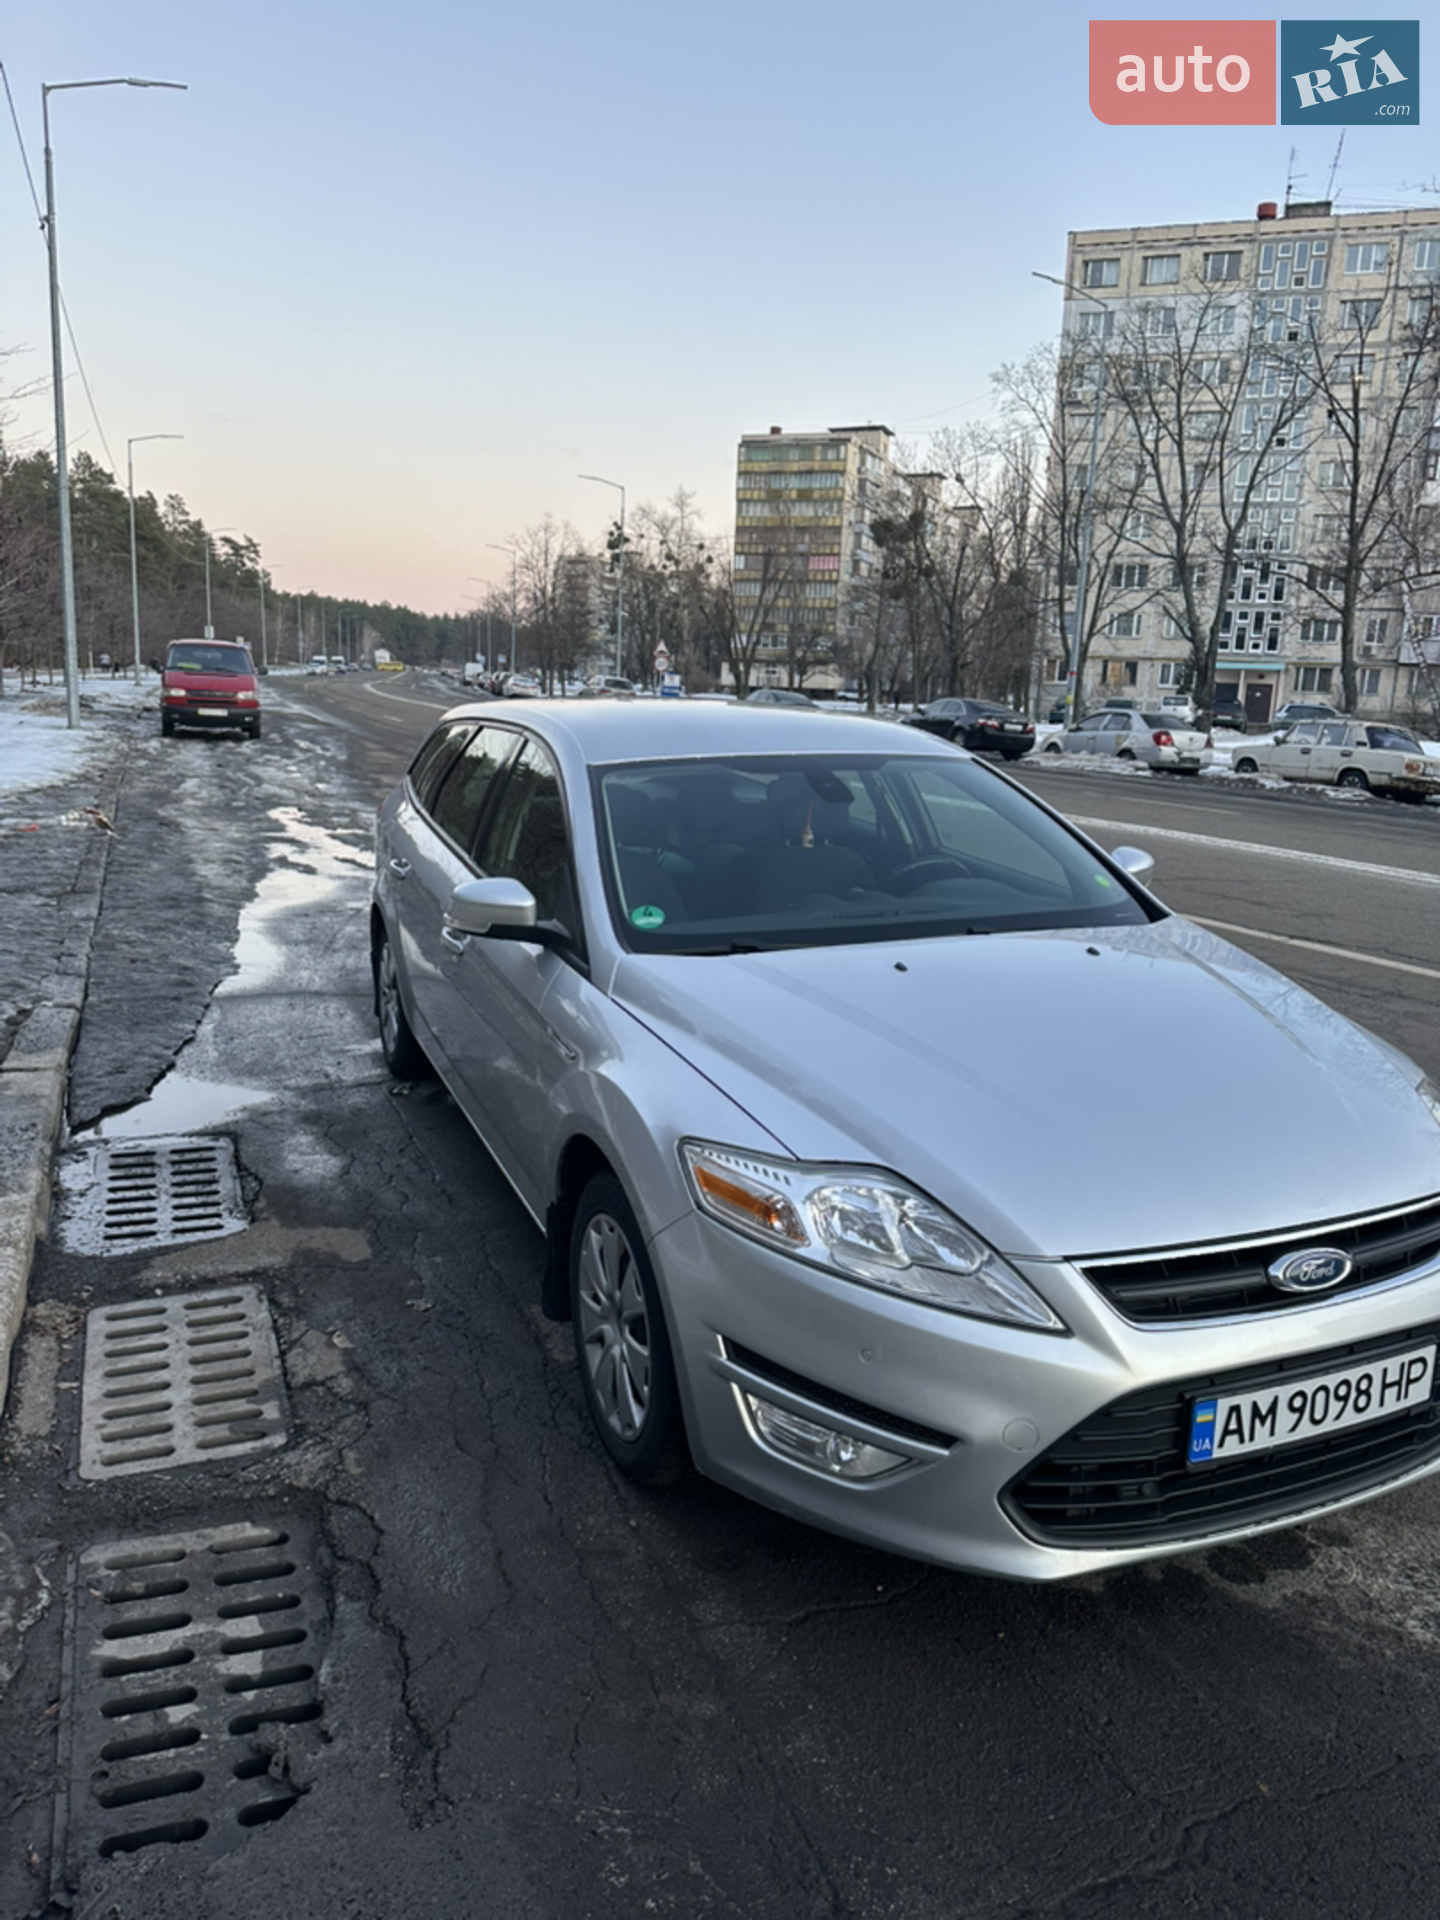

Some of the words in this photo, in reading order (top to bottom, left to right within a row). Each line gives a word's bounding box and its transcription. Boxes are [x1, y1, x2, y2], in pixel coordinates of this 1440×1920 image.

[642, 906, 653, 917] 4
[1299, 1258, 1335, 1281] Ford
[1217, 1394, 1279, 1448] AM
[1287, 1373, 1373, 1433] 9098
[1379, 1356, 1428, 1407] HP
[1193, 1438, 1211, 1451] UA
